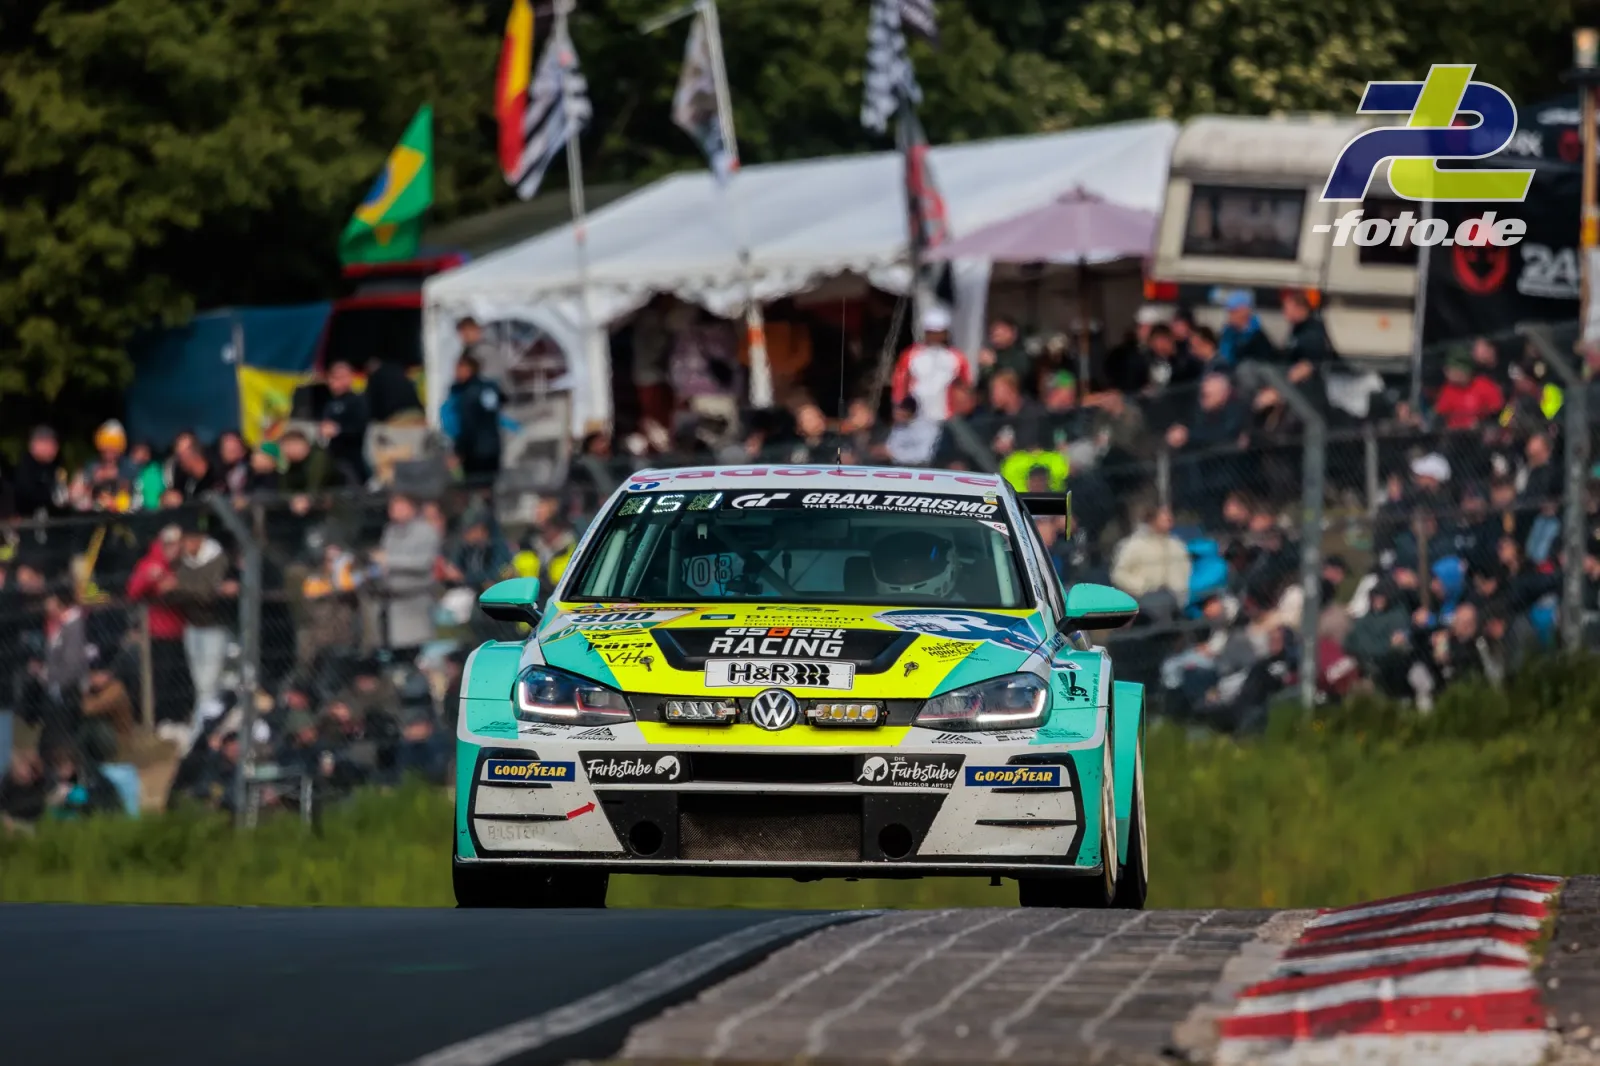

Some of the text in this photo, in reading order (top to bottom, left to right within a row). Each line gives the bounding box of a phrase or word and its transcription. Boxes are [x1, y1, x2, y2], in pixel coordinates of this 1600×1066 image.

[802, 492, 998, 515] GRAN TURISMO
[868, 505, 917, 513] DRIVING
[920, 508, 992, 519] SIMULATOR
[572, 611, 655, 624] 800
[558, 622, 645, 638] DEKRA
[708, 637, 845, 657] RACING
[729, 662, 795, 685] H&R
[494, 763, 567, 779] GOODYEAR
[586, 758, 653, 779] Farbstube
[890, 762, 957, 781] Farbstube
[974, 767, 1053, 784] GOODYEAR
